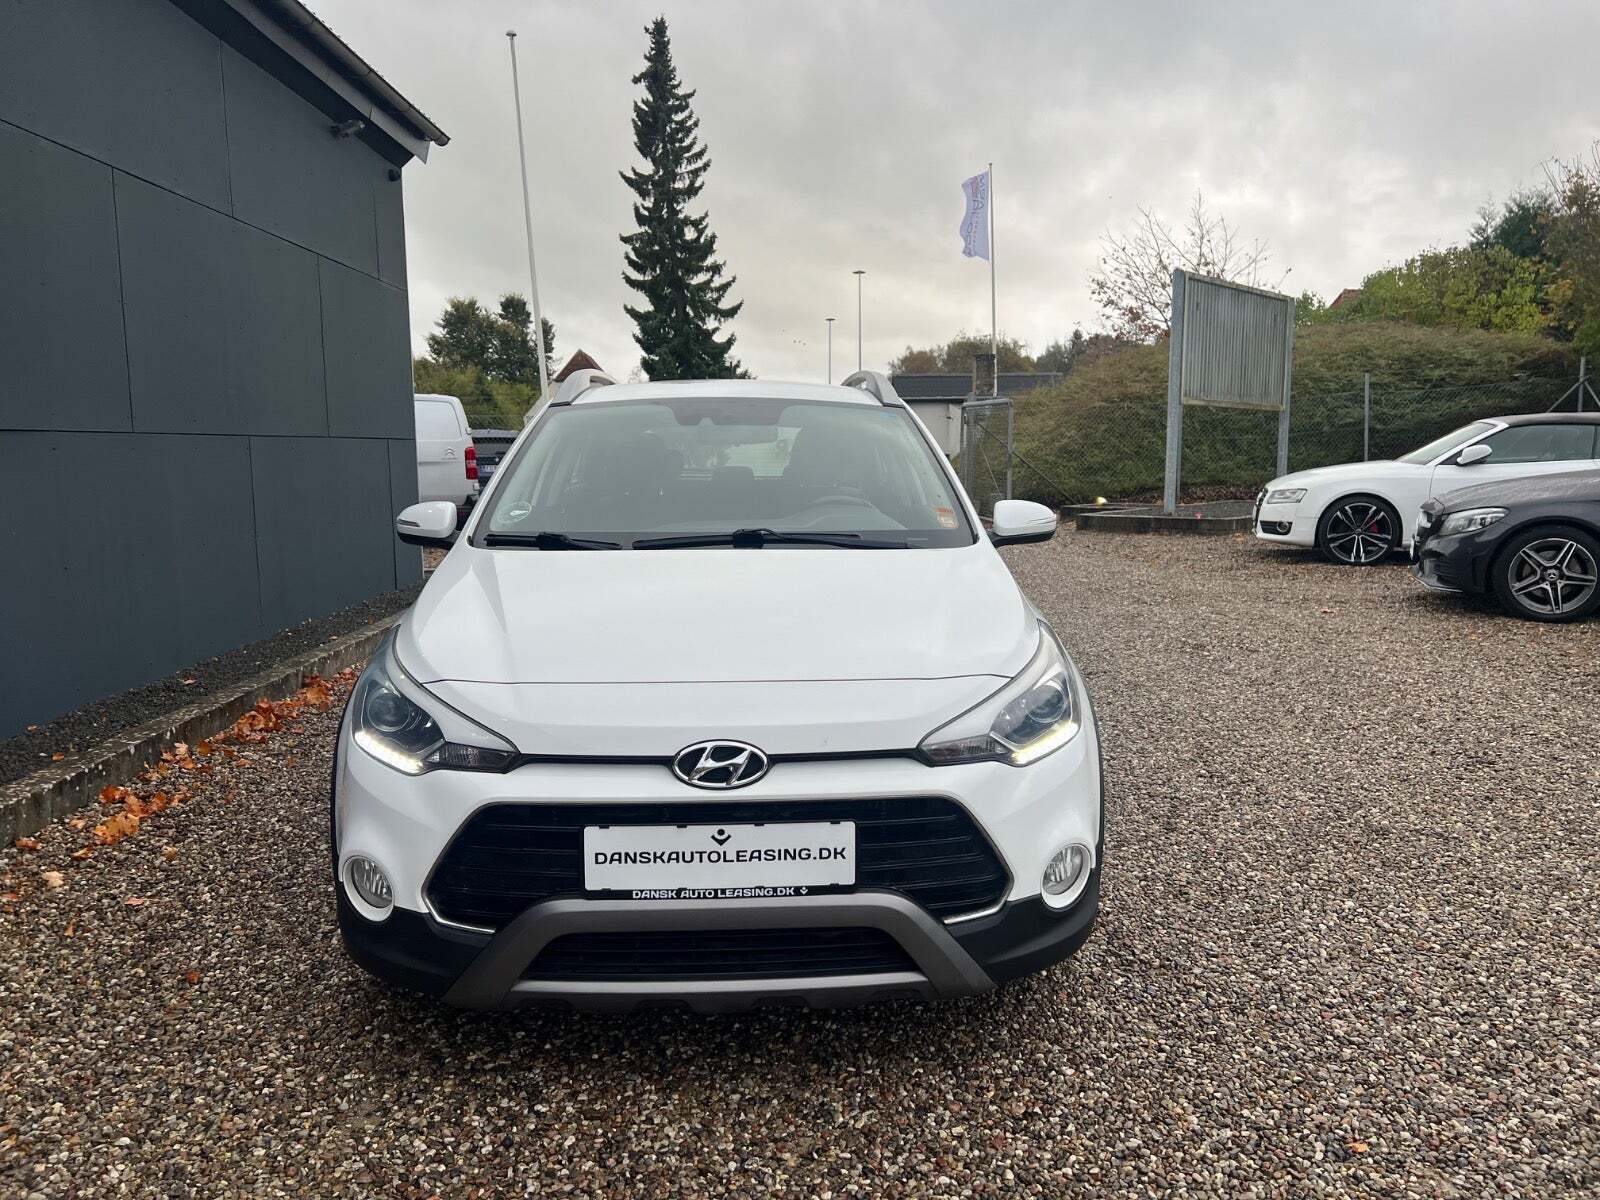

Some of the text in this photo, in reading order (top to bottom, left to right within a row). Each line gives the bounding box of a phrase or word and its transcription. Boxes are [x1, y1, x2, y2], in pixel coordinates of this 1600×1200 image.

[594, 847, 847, 865] DANSKAUTOLEASING.DK
[632, 887, 795, 899] DANSK AUTO LEASING.DK
